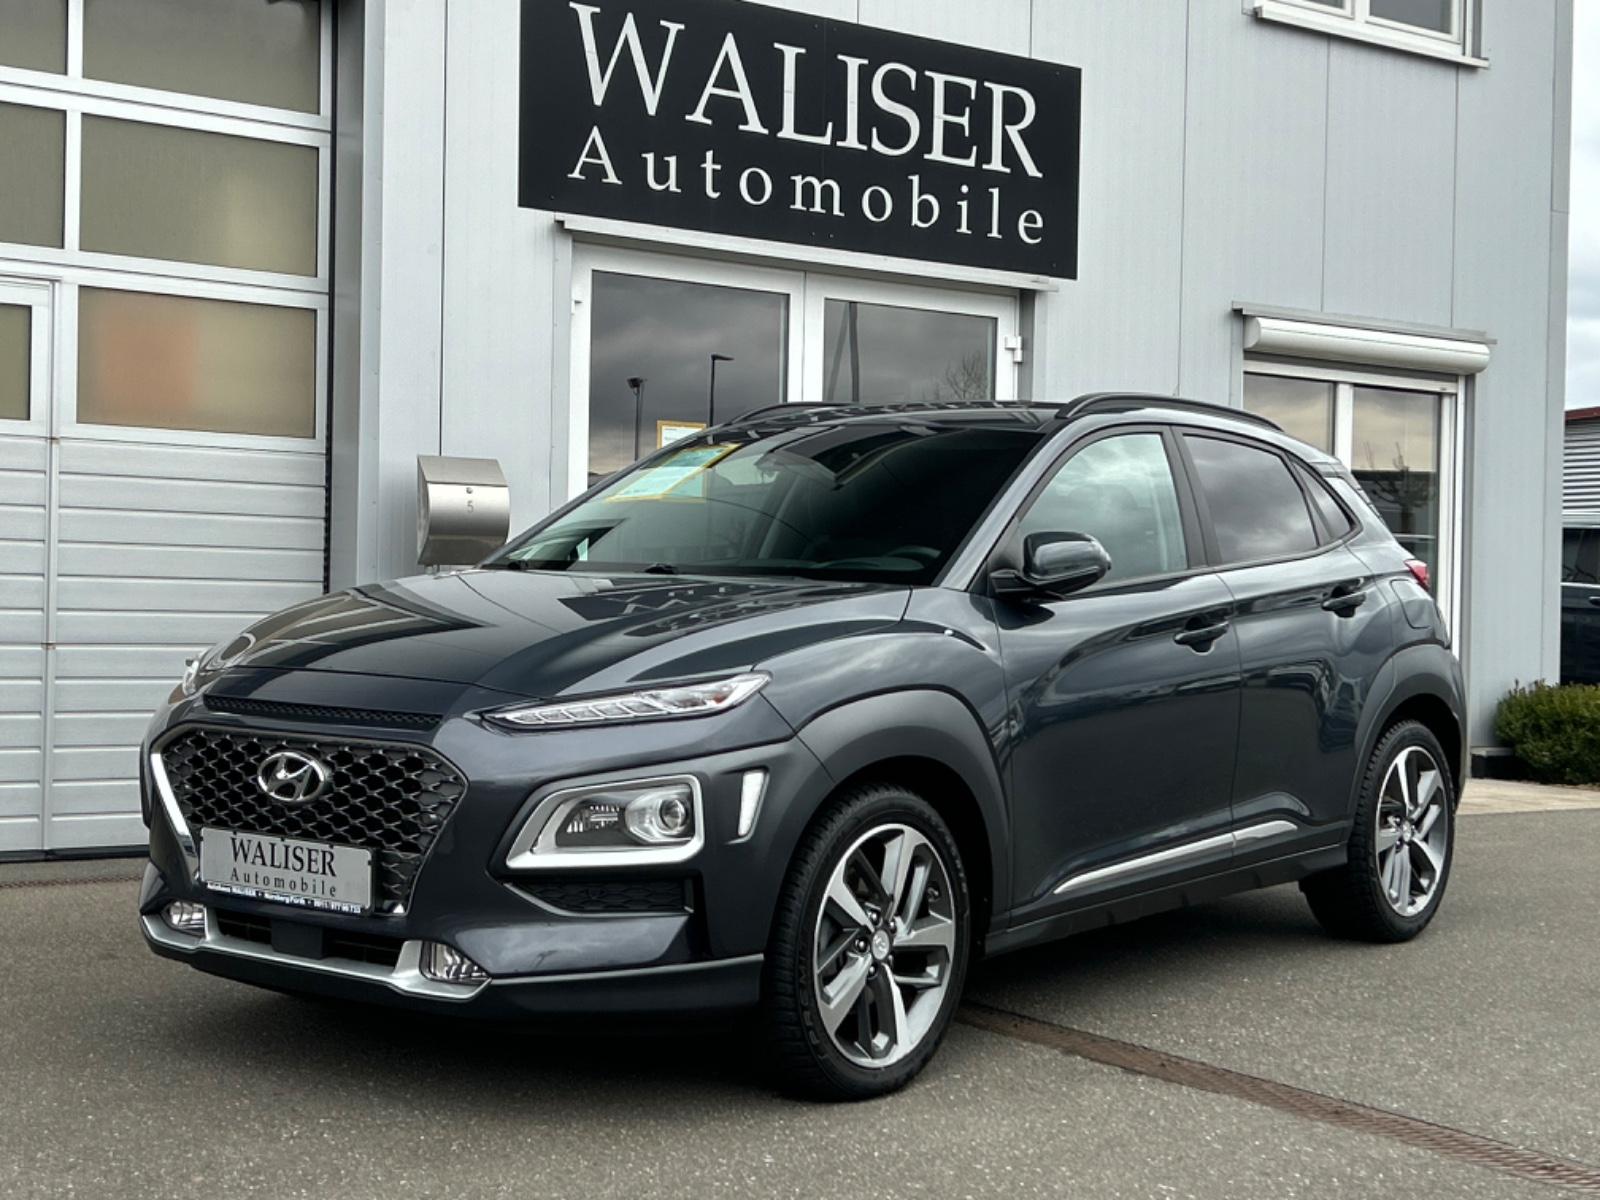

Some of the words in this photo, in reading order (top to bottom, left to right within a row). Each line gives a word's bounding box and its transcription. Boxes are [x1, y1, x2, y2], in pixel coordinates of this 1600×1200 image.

[569, 2, 1043, 179] WALISER
[567, 125, 1044, 245] Automobile
[466, 500, 474, 514] 5
[230, 836, 337, 877] WALISER
[230, 867, 337, 897] Automobile
